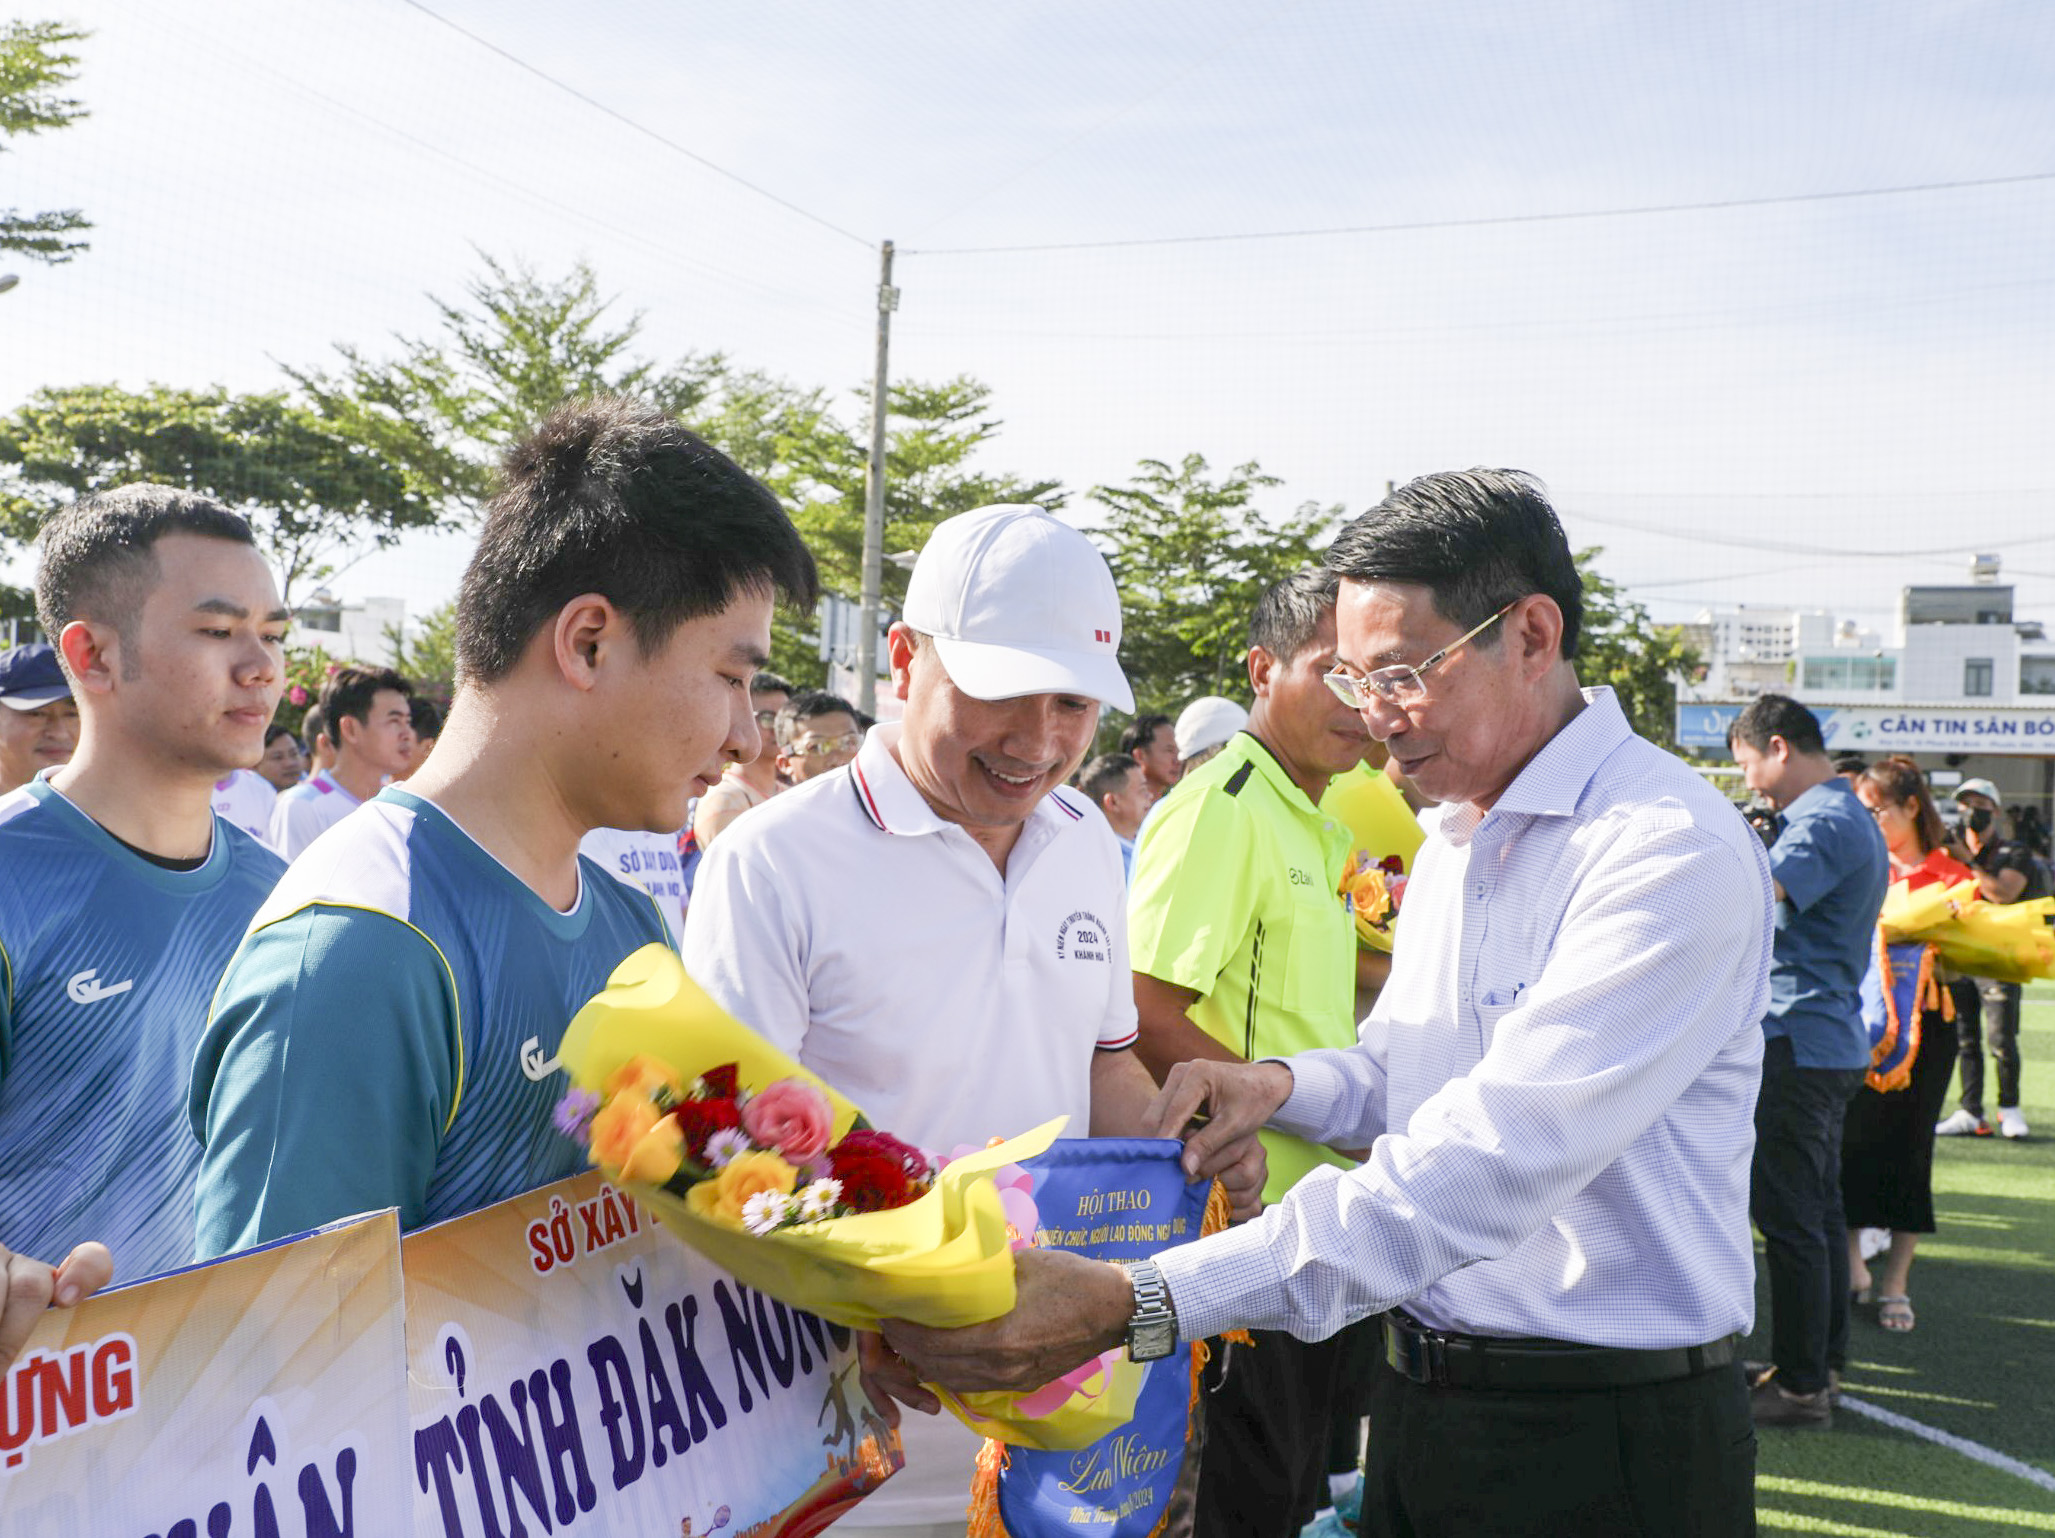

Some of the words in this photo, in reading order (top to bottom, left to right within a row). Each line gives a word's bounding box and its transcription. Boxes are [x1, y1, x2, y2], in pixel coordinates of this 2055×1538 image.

[1933, 719, 1967, 734] TIN
[1077, 930, 1098, 944] 2024
[1077, 1187, 1104, 1220] HỘI
[1107, 1189, 1151, 1213] THAO
[529, 1200, 575, 1272] SỞ
[579, 1186, 638, 1253] XÂY
[1110, 1225, 1125, 1243] LAO
[1127, 1220, 1154, 1245] ĐỘNG
[414, 1336, 597, 1538] TỈNH
[1109, 1433, 1168, 1483] Niệm
[1068, 1506, 1092, 1524] Nha
